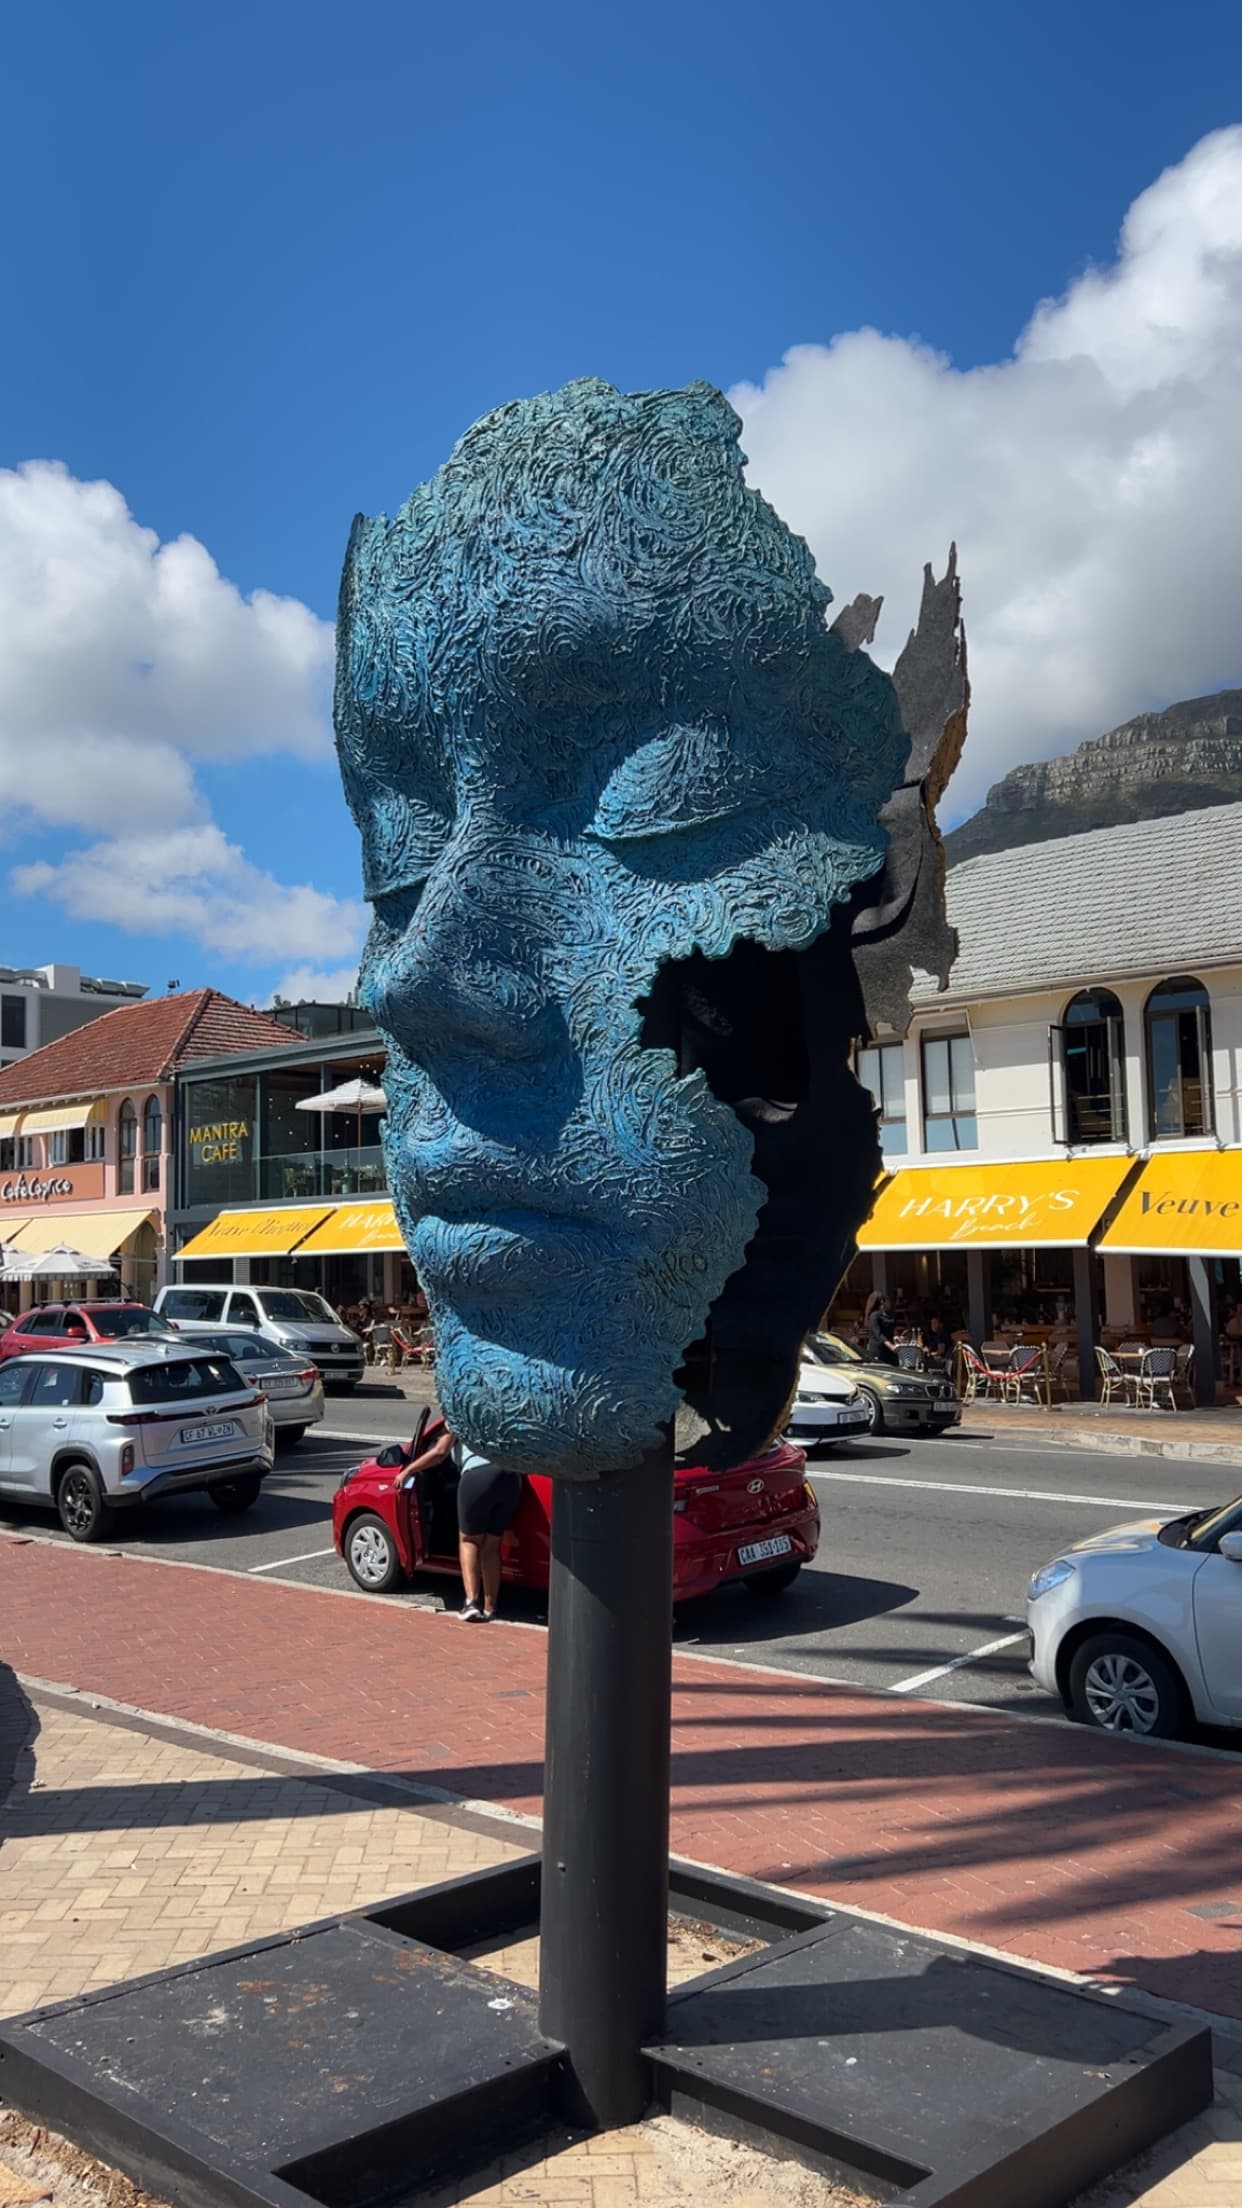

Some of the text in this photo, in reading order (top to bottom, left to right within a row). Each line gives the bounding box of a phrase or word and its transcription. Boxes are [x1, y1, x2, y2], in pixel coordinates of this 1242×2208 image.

[190, 1121, 249, 1144] MANTRA
[899, 1190, 1080, 1217] HARRY'S
[1139, 1191, 1240, 1217] Veuve
